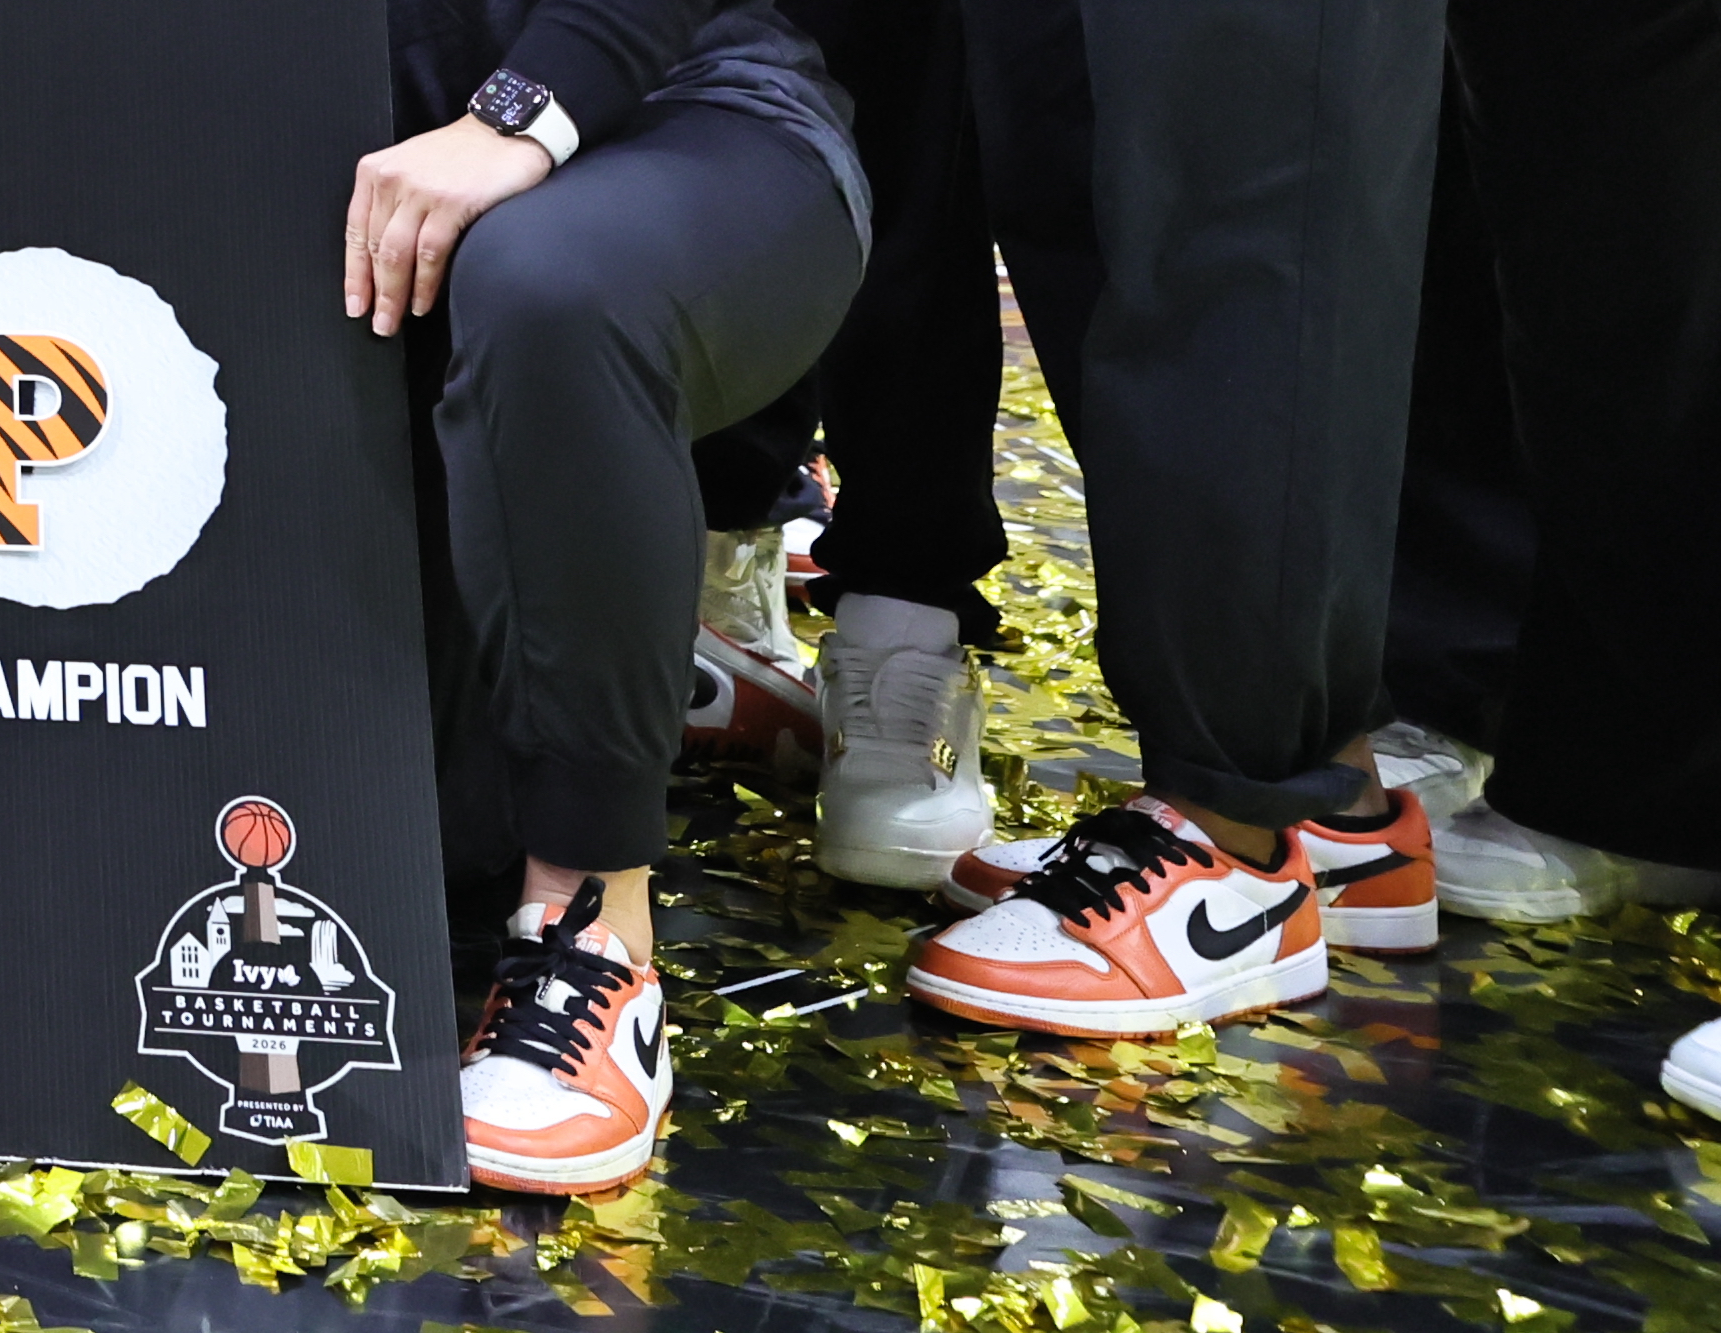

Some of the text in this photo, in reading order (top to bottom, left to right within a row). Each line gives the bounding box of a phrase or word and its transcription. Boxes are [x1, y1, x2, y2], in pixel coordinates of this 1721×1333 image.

[232, 958, 278, 990] Ivy
[175, 995, 360, 1020] BASKETBALL
[162, 1010, 375, 1038] TOURNAMENTS
[251, 1039, 287, 1051] 2026
[237, 1099, 305, 1113] PRESENTED BY
[263, 1114, 294, 1130] TIAA
